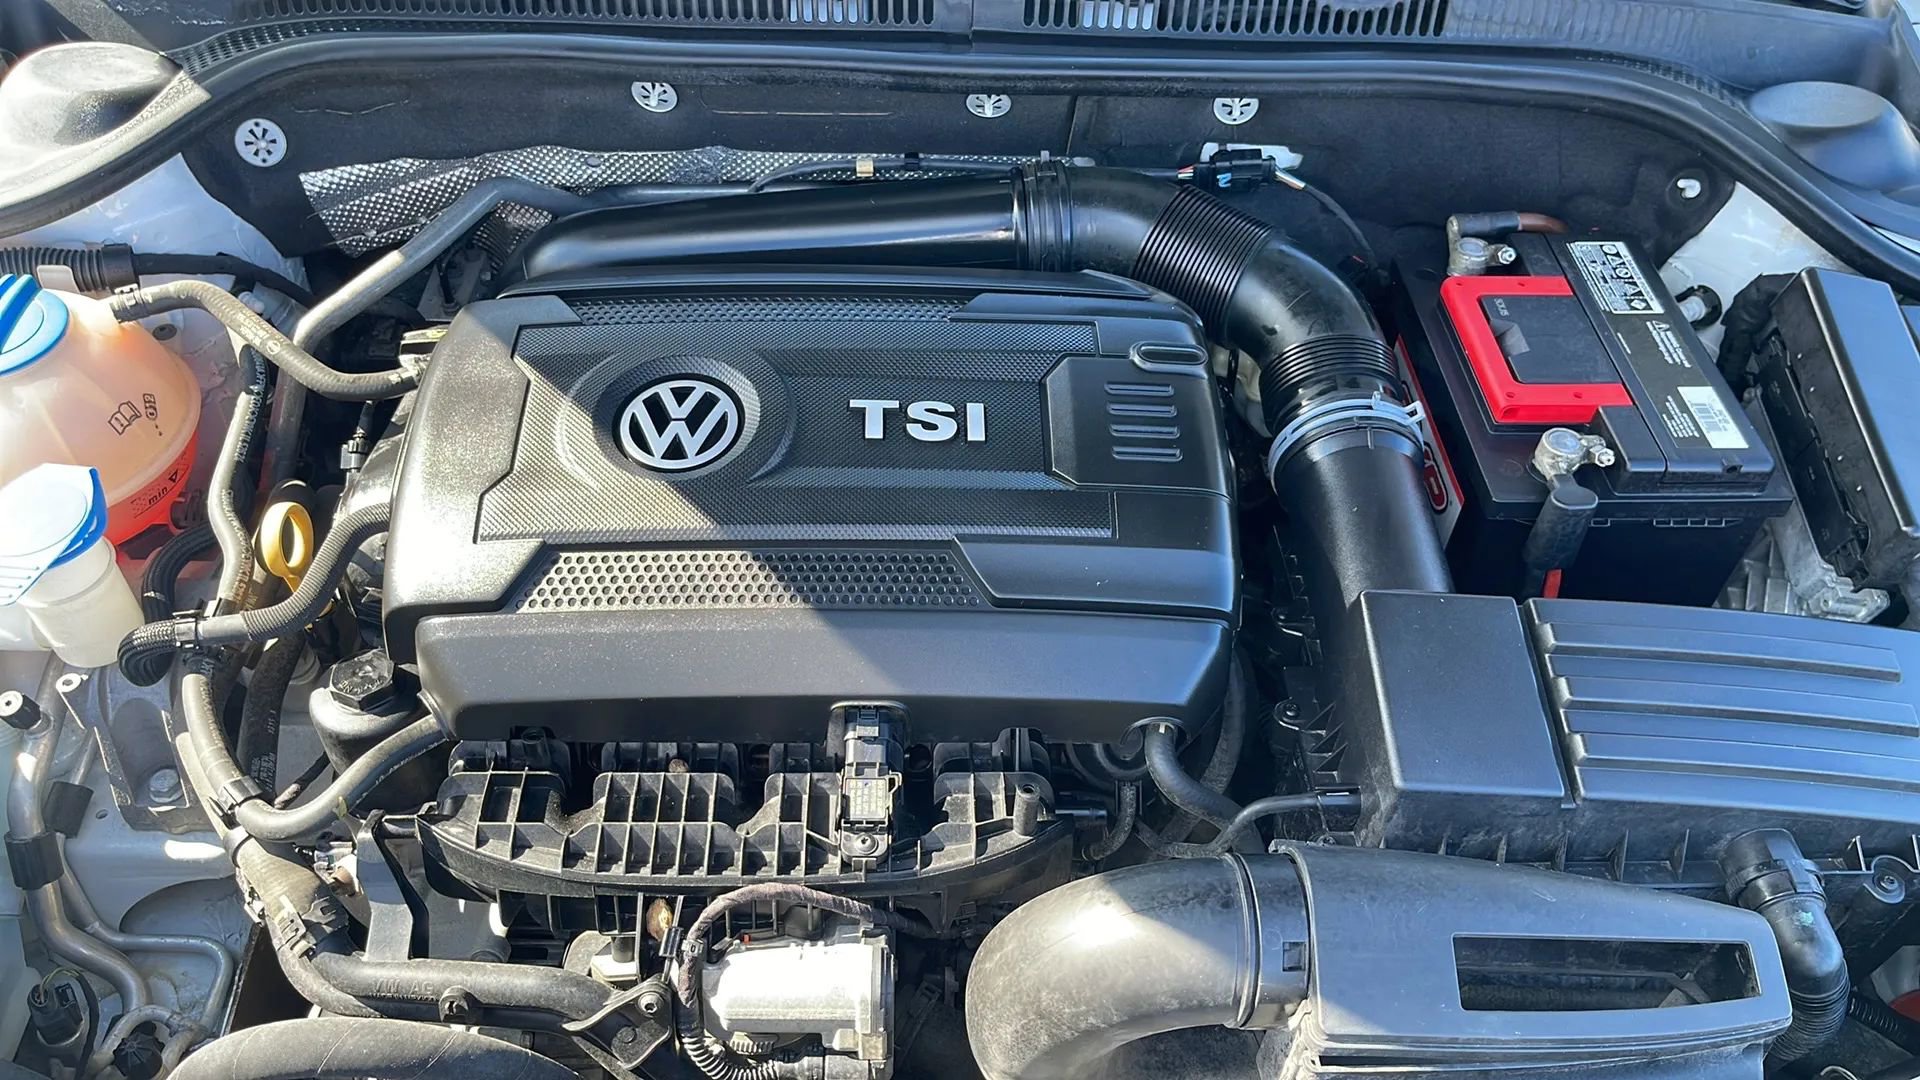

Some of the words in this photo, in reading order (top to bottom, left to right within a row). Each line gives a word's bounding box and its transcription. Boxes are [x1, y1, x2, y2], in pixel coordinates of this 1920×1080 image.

[620, 379, 739, 470] VW
[850, 399, 986, 442] TSI
[148, 486, 168, 506] min
